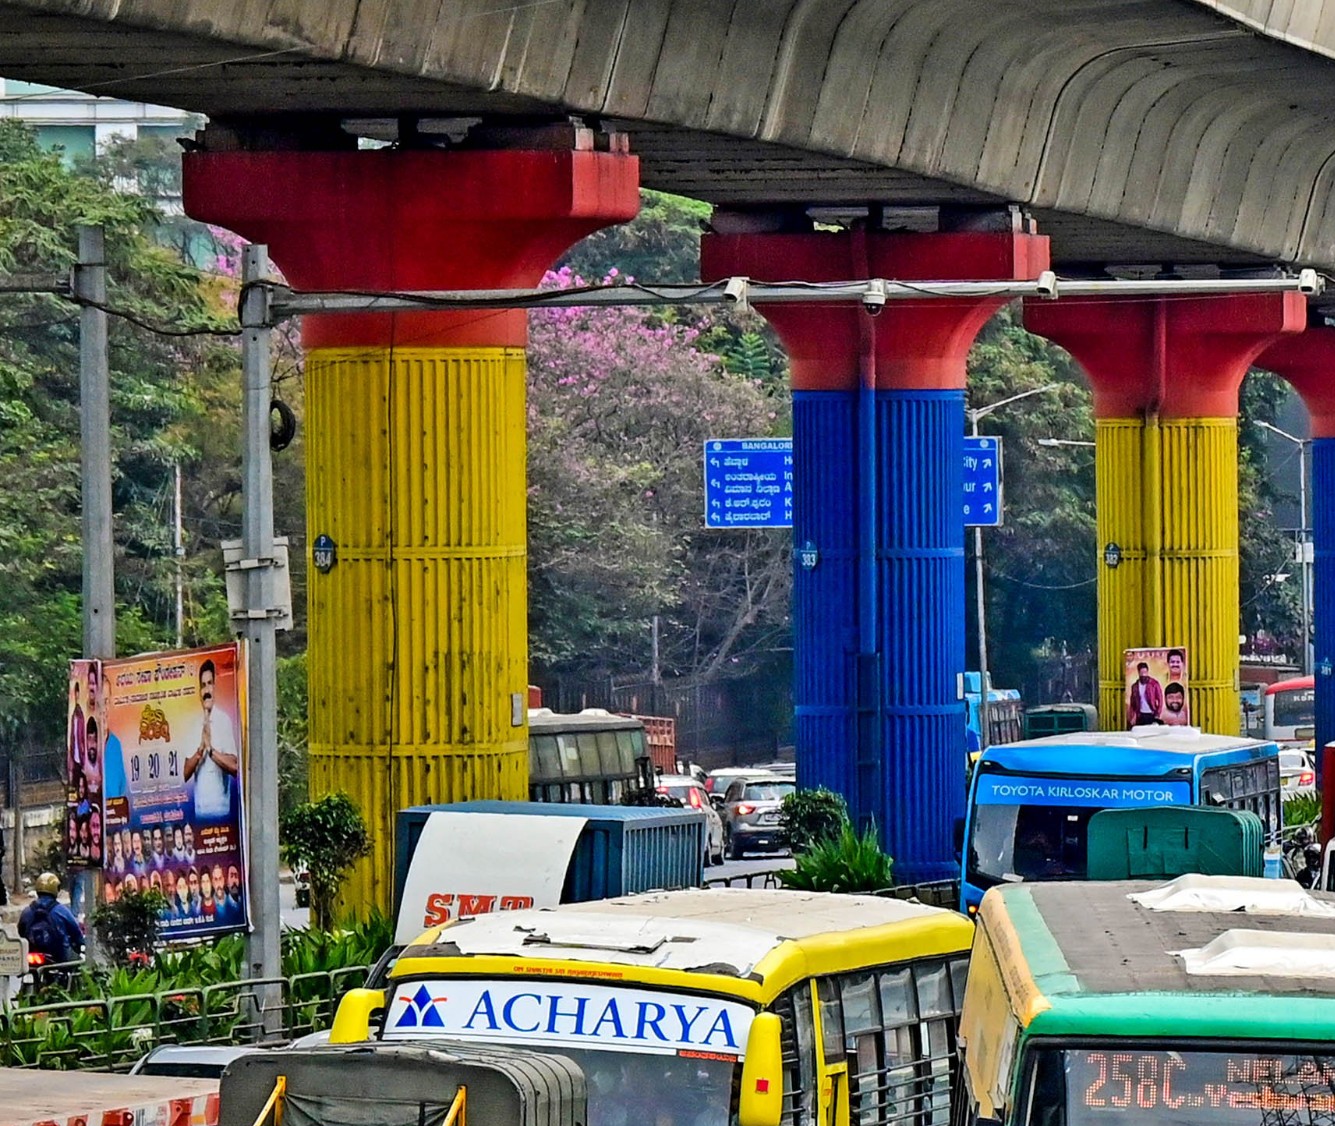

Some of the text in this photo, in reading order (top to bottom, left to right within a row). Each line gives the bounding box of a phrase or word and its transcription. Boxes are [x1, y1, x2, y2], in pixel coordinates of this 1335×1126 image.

[742, 442, 793, 450] BANGALOR
[314, 552, 331, 567] 384
[801, 553, 816, 567] 383
[130, 750, 179, 782] 19 20 21
[991, 785, 1174, 802] TOYOTA KIRLOSKAR MOTOR
[461, 989, 740, 1049] ACHARYA
[1084, 1053, 1187, 1109] 258C
